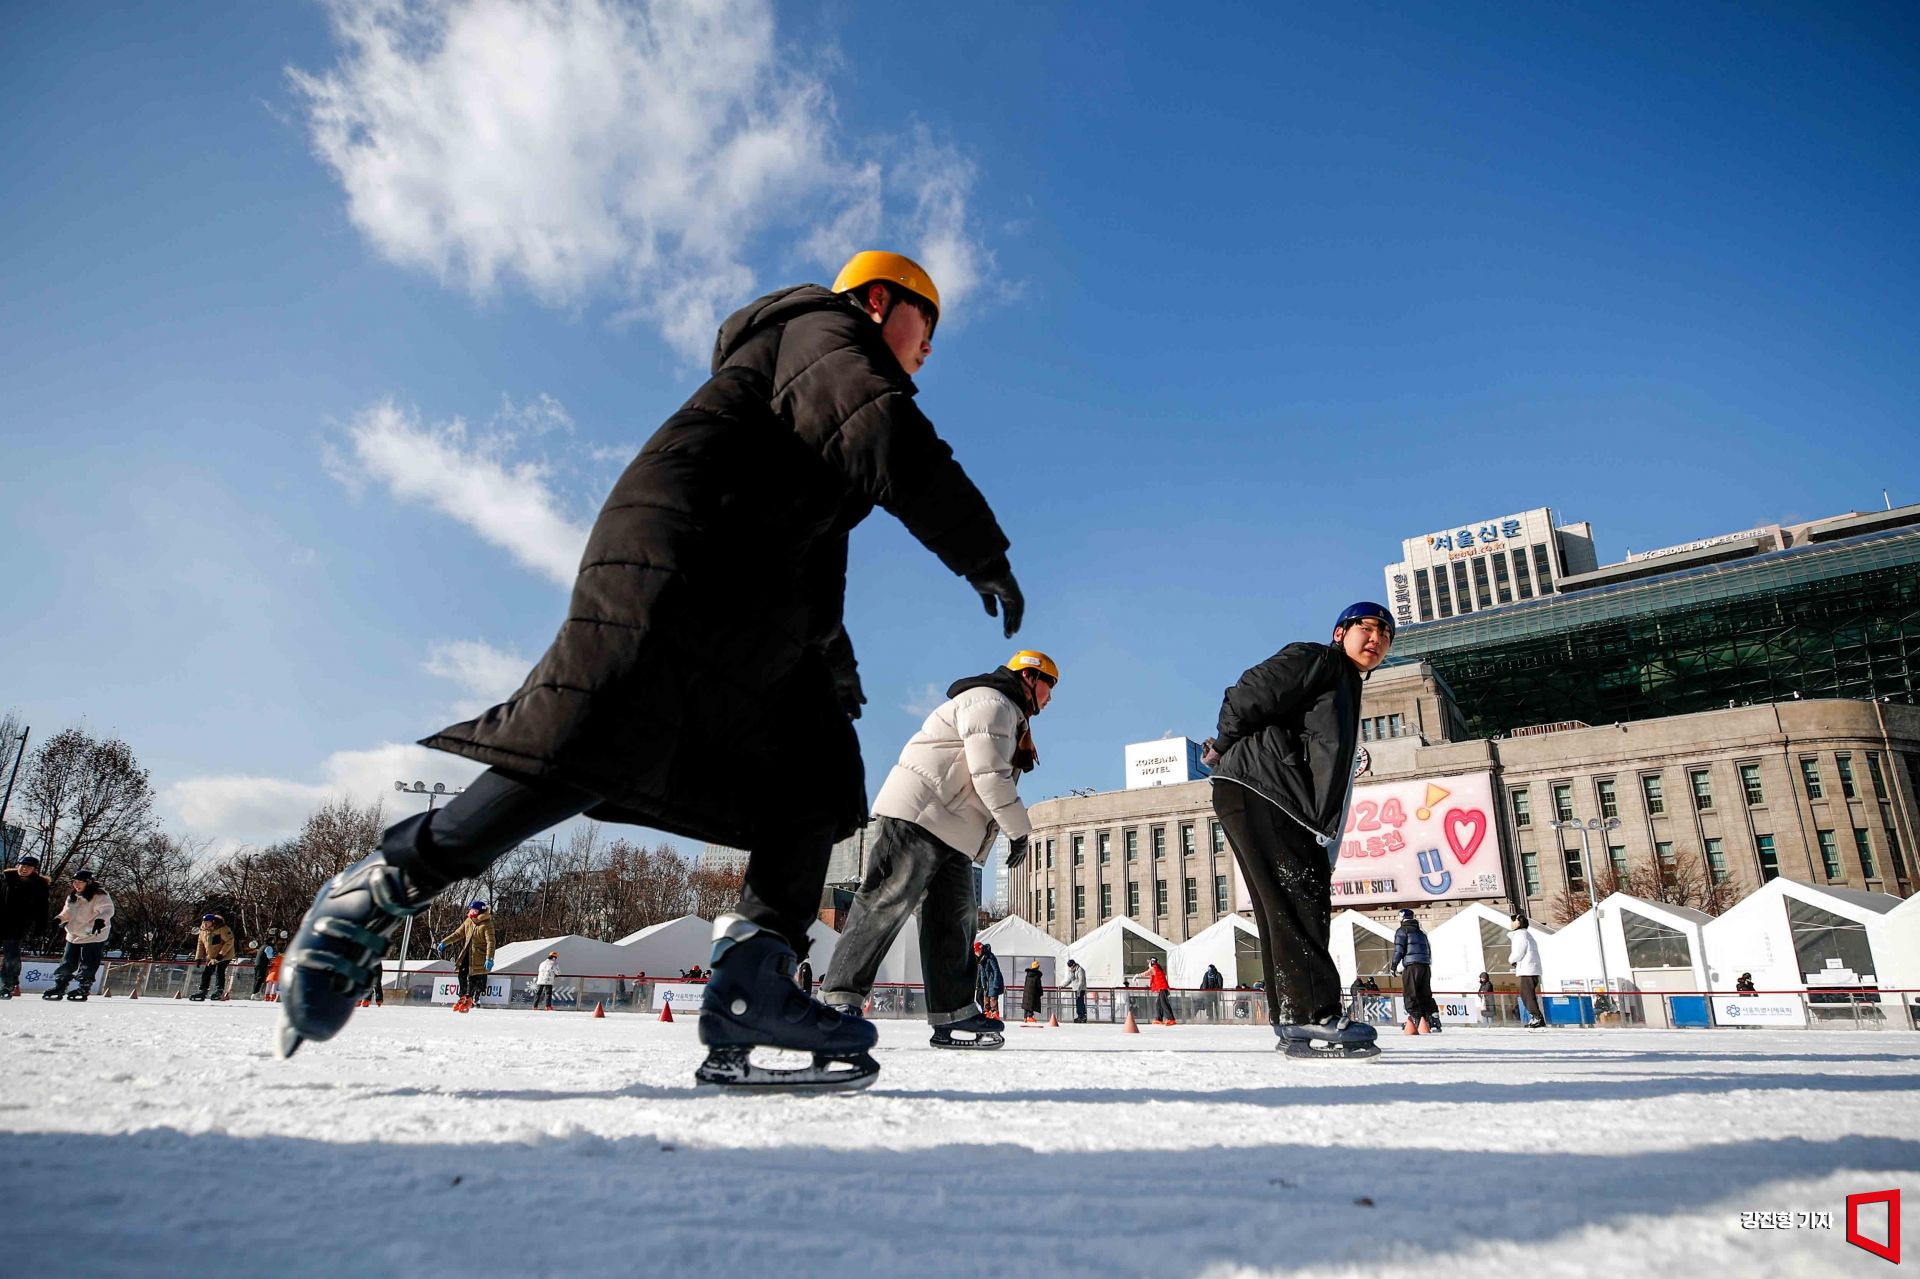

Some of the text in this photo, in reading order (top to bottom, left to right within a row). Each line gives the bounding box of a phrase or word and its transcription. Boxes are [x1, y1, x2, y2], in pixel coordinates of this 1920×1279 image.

[1433, 519, 1522, 551] 서울신문
[1658, 545, 1688, 557] SEOUL
[1690, 536, 1731, 551] FINANCE
[1732, 528, 1767, 541] CENTER
[1142, 766, 1170, 776] HOTEL
[1446, 1004, 1470, 1017] SOUL
